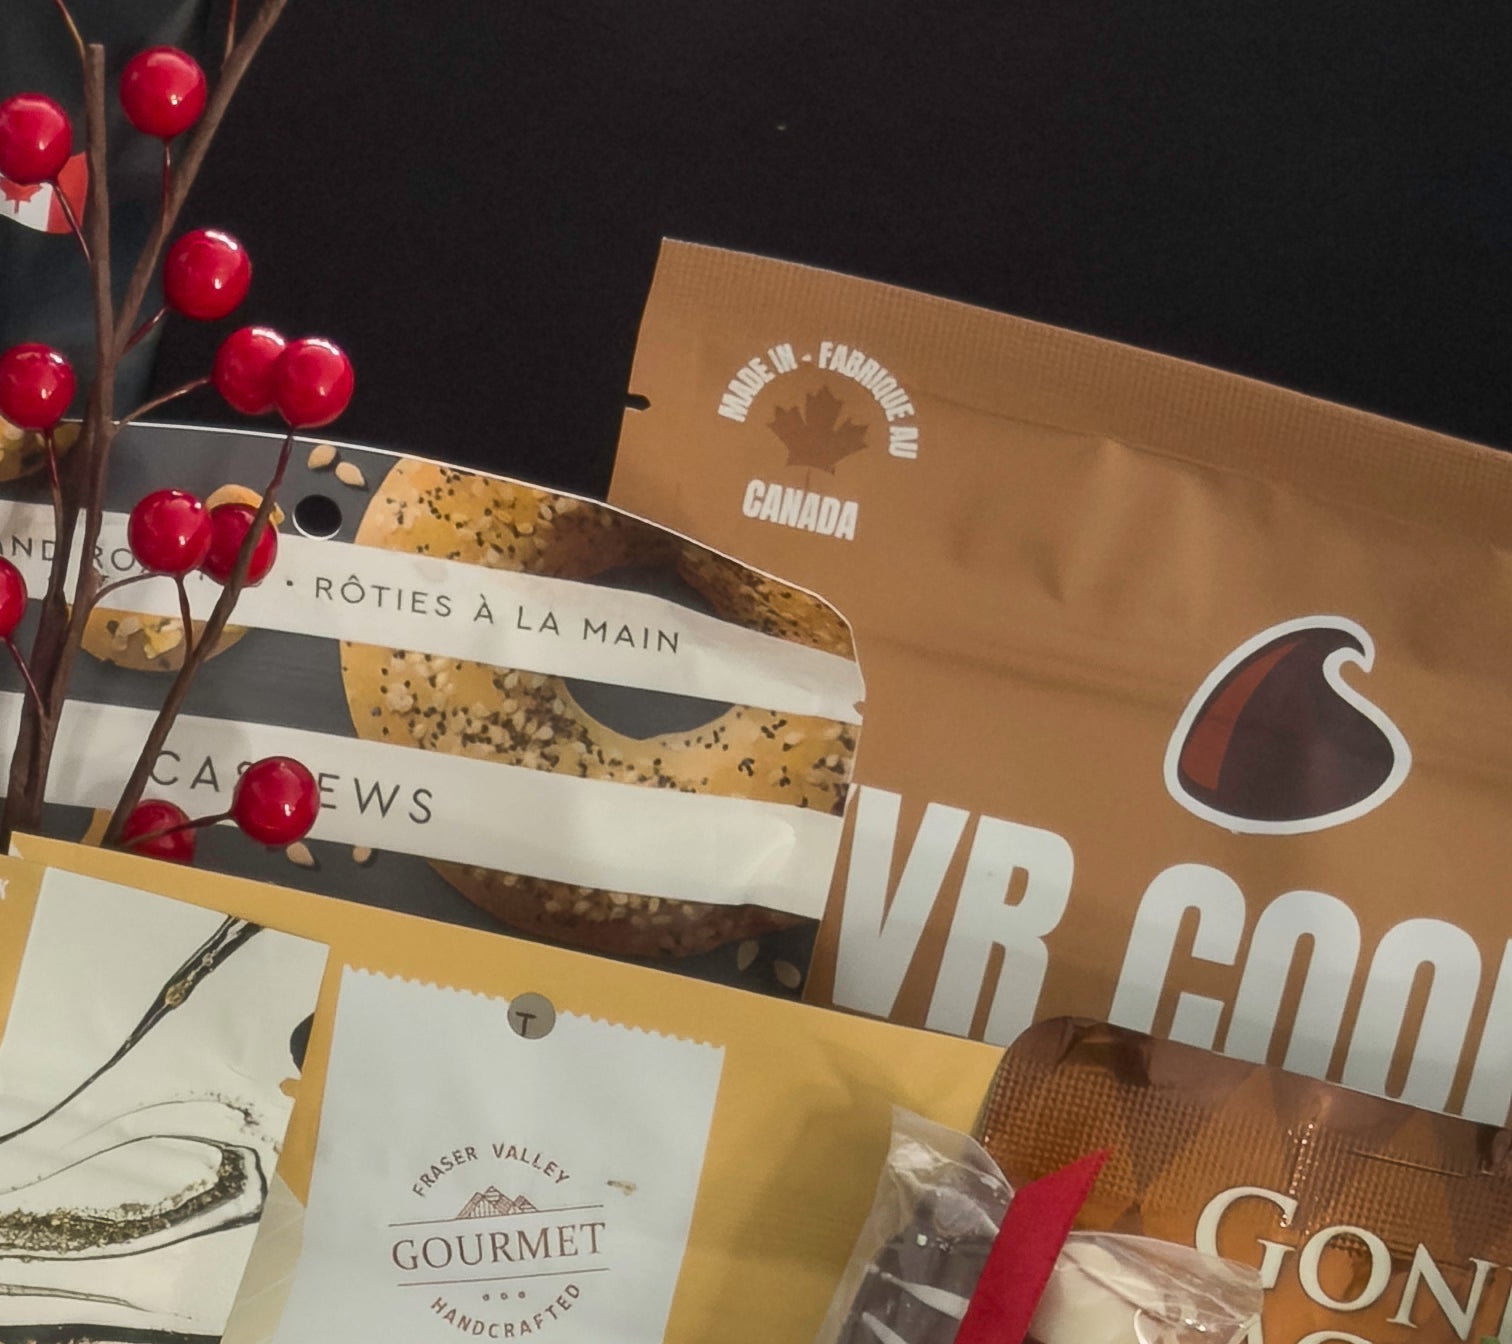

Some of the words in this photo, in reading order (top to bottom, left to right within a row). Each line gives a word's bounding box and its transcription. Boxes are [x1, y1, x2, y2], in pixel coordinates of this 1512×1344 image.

[718, 357, 776, 422] MADE
[767, 343, 798, 374] IN
[889, 426, 919, 459] AU
[742, 480, 859, 541] CANADA
[315, 575, 451, 617] RÔTIES
[473, 594, 494, 624] À
[517, 606, 560, 636] LA
[583, 618, 680, 654] MAIN
[149, 750, 433, 825] CAEWS
[831, 783, 1074, 1048] VR
[412, 1146, 479, 1197] FRASER
[492, 1143, 570, 1184] VALLEY
[392, 1222, 606, 1271] GOURMET
[431, 1283, 580, 1338] HANDCRAFTED
